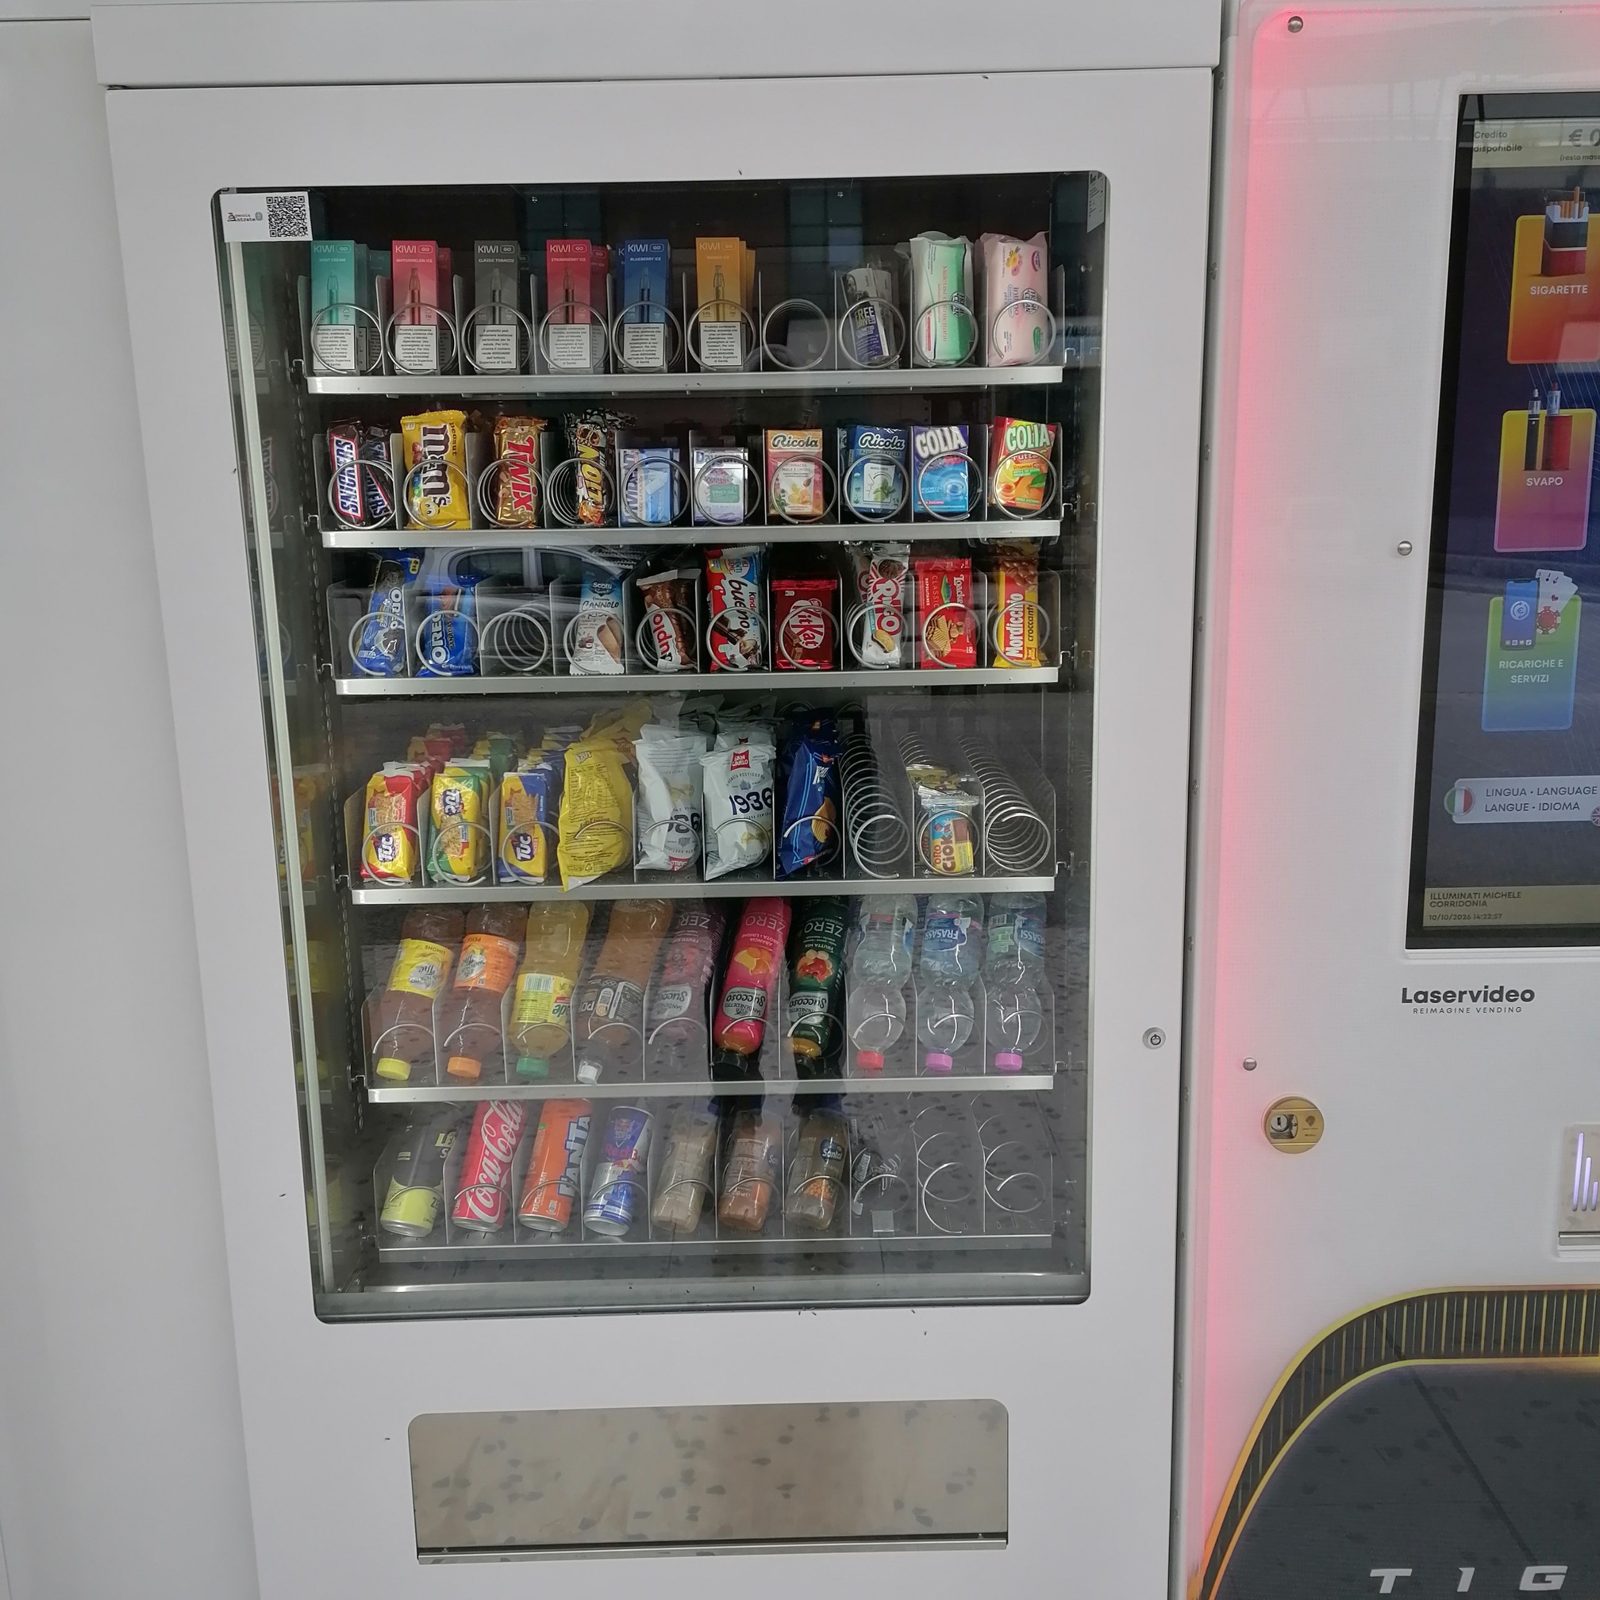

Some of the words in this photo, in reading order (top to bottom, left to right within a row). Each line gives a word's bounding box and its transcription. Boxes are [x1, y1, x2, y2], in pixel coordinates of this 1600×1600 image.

[1474, 130, 1508, 139] Credito
[1473, 143, 1523, 154] disponibile
[313, 245, 335, 254] KIWI
[395, 245, 417, 254] KIWI
[477, 245, 499, 254] KIWI
[549, 244, 571, 253] KIWI
[627, 244, 649, 252] KIWI
[699, 242, 721, 250] KIWI
[1530, 284, 1589, 295] SIGARETTE
[771, 433, 819, 448] Ricola
[859, 432, 905, 450] Ricola
[915, 425, 968, 460] GOLIA
[1005, 423, 1051, 452] GOLIA
[1525, 476, 1564, 488] SVAPO
[953, 574, 965, 607] Loacke
[728, 579, 751, 629] bueno
[652, 613, 673, 656] uplo
[1499, 659, 1555, 669] RICARICHE
[1557, 659, 1564, 668] E
[1510, 674, 1550, 684] SERVIZI
[1485, 788, 1527, 797] LINGUA
[1536, 786, 1598, 796] LANGUAGE
[444, 789, 461, 816] TUC
[728, 787, 773, 816] 1936
[1484, 803, 1529, 812] LANGUE
[1538, 802, 1580, 811] IDIOMA
[377, 836, 394, 862] TUC
[515, 835, 532, 860] TUC
[933, 844, 941, 865] ORO
[1430, 892, 1481, 900] ILLUMINATI
[1482, 891, 1522, 899] MICHELE
[1429, 900, 1488, 908] CORRIDONIA
[679, 914, 710, 929] ZER
[745, 914, 786, 934] ZERO
[804, 923, 842, 938] ZERO
[726, 993, 766, 1009] Succoso
[789, 994, 827, 1008] Succoso
[1401, 985, 1536, 1004] Laservideo
[1412, 1007, 1471, 1015] REIMAGINE
[1475, 1006, 1523, 1014] VENDING
[558, 1116, 592, 1198] FANTA
